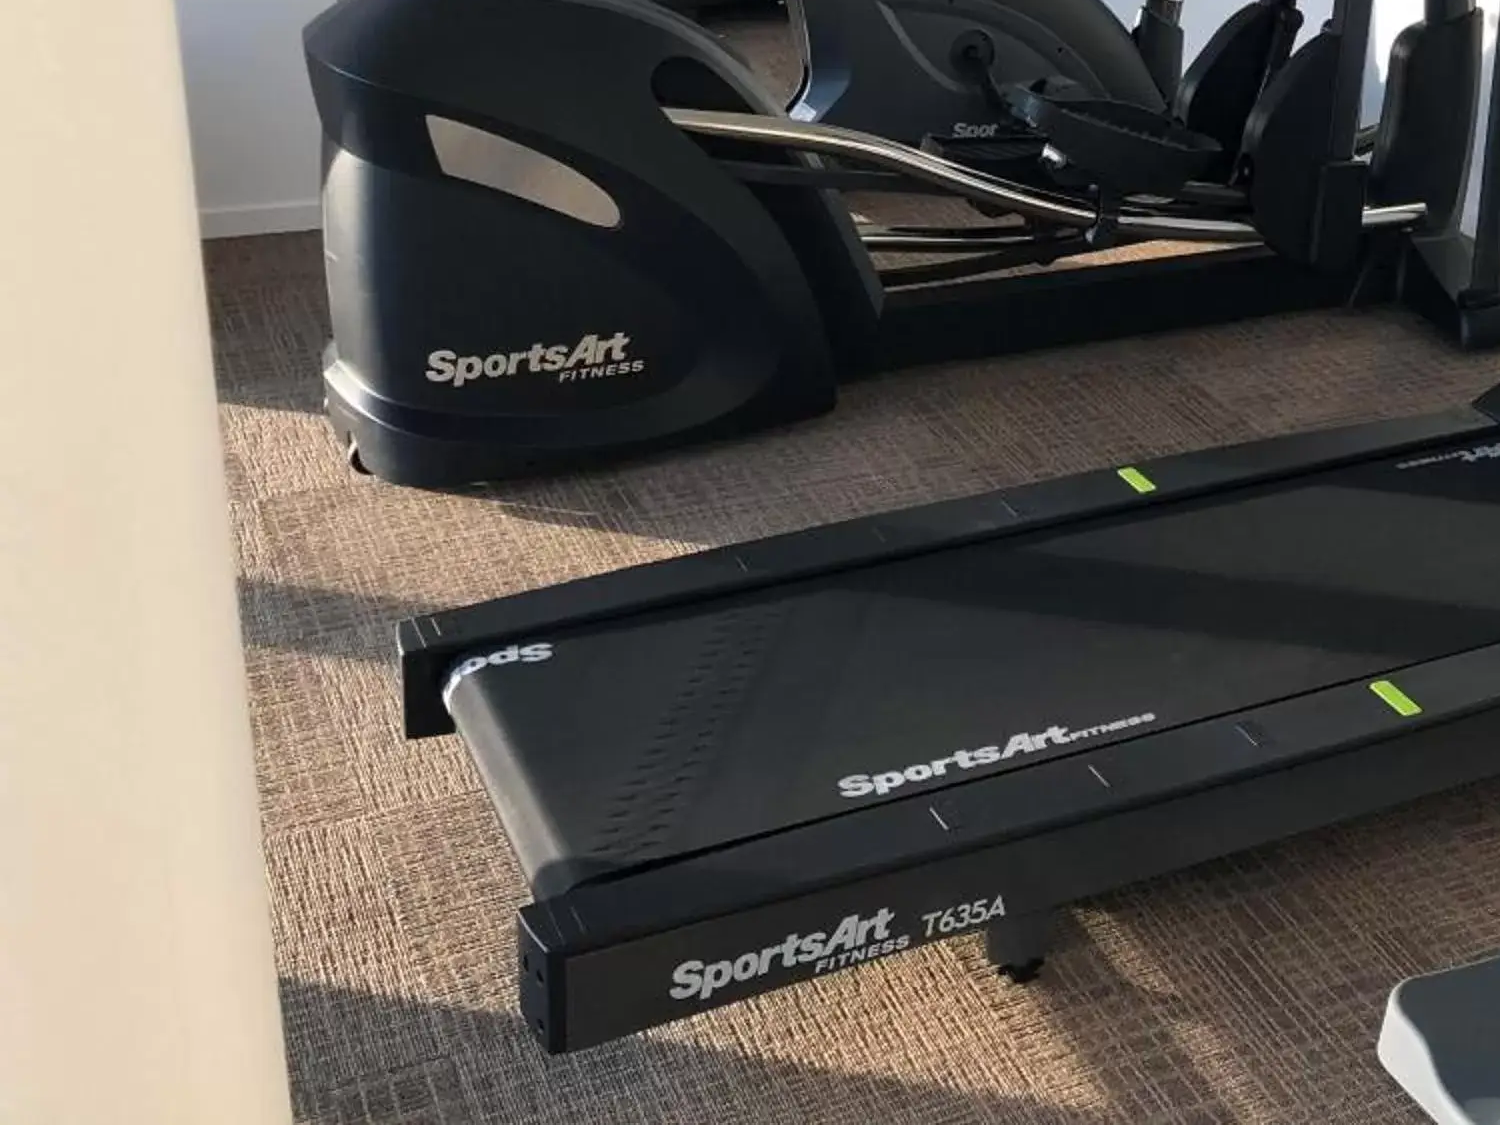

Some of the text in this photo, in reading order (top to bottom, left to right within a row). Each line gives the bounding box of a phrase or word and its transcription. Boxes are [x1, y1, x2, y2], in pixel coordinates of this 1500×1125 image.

[425, 332, 630, 388] SportsArt
[559, 360, 645, 383] FITNESS
[837, 712, 1156, 797] SportsArt FITNESS
[669, 895, 1006, 1000] SportsArt T635A
[814, 934, 911, 974] FITNESS
